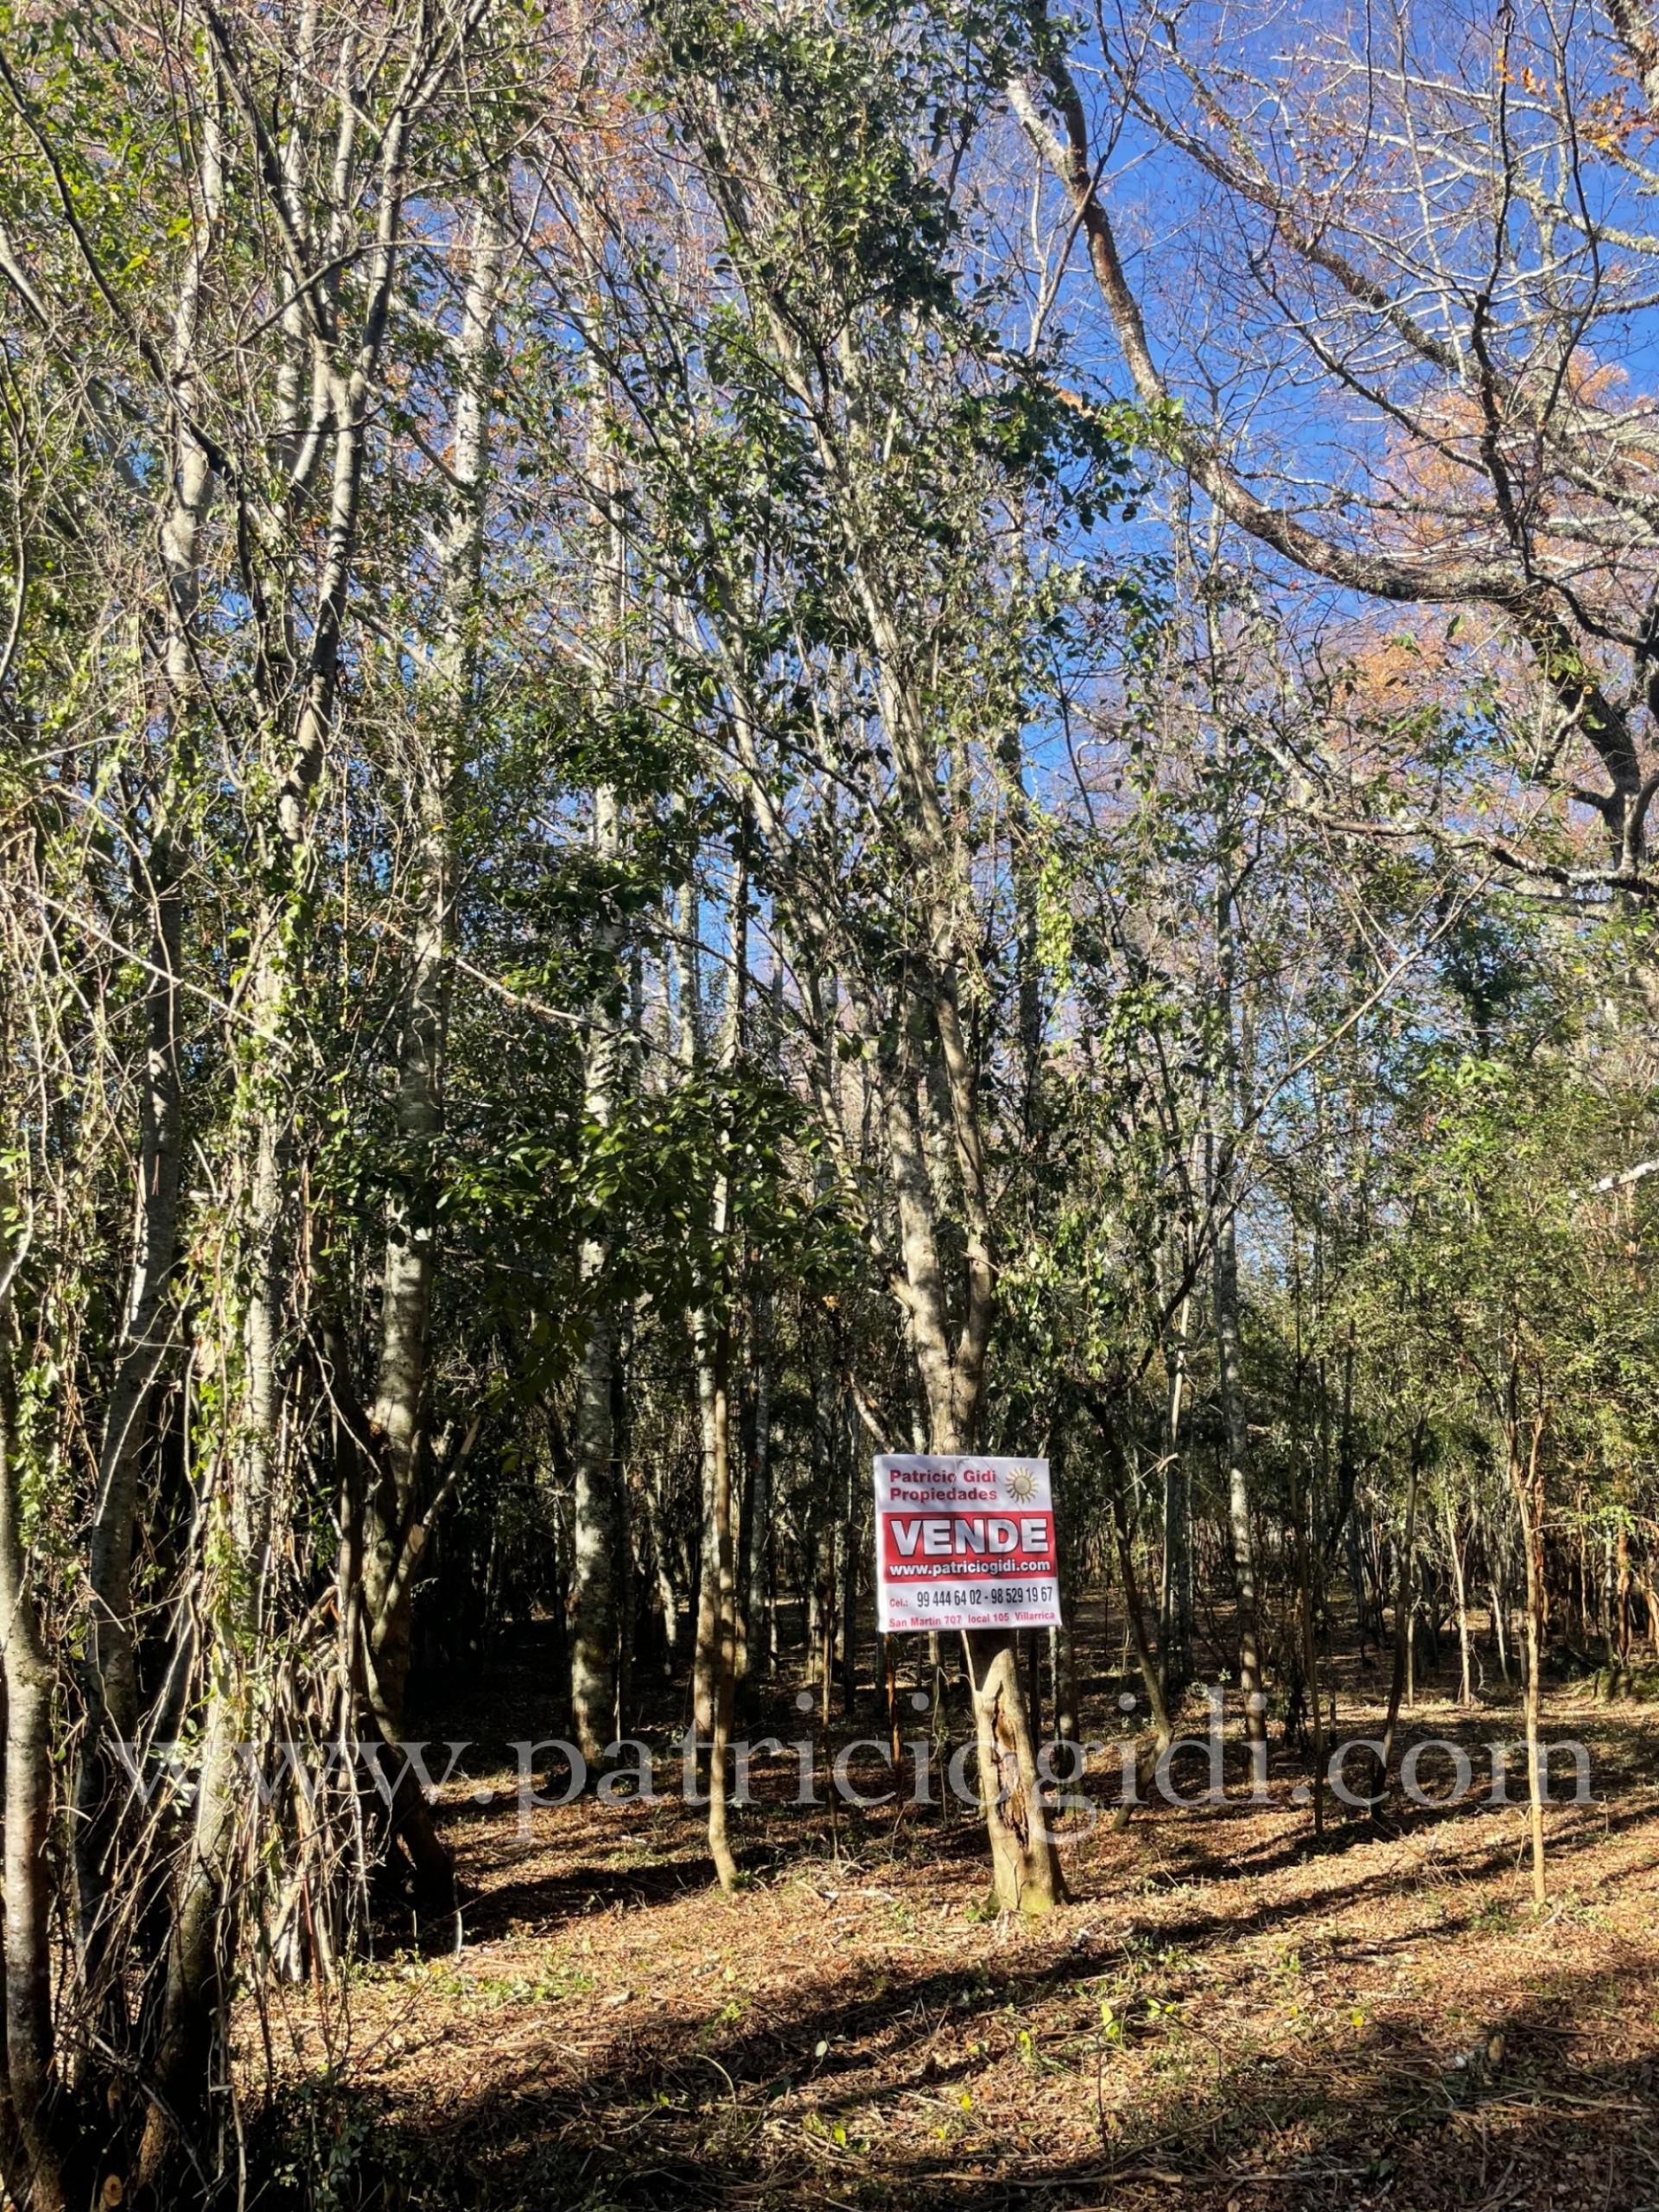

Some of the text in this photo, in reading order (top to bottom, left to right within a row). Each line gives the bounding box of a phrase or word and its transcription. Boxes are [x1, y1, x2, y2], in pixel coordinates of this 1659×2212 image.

[889, 1469, 997, 1484] Patricio Gidi
[889, 1487, 998, 1503] Propiedades
[890, 1517, 1050, 1556] VENDE
[889, 1559, 1051, 1578] www.patriciogidi.com
[917, 1591, 930, 1608] 99
[932, 1590, 951, 1607] 444
[954, 1590, 967, 1606] 64
[969, 1588, 982, 1605] 02
[991, 1588, 1003, 1605] 98
[1006, 1586, 1023, 1604] 529
[1026, 1586, 1039, 1603] 19
[1040, 1586, 1052, 1602] 67
[889, 1618, 907, 1628] San
[944, 1614, 962, 1625] 707
[968, 1613, 990, 1624] local
[994, 1612, 1009, 1623] 105
[1014, 1611, 1055, 1621] Villarrica
